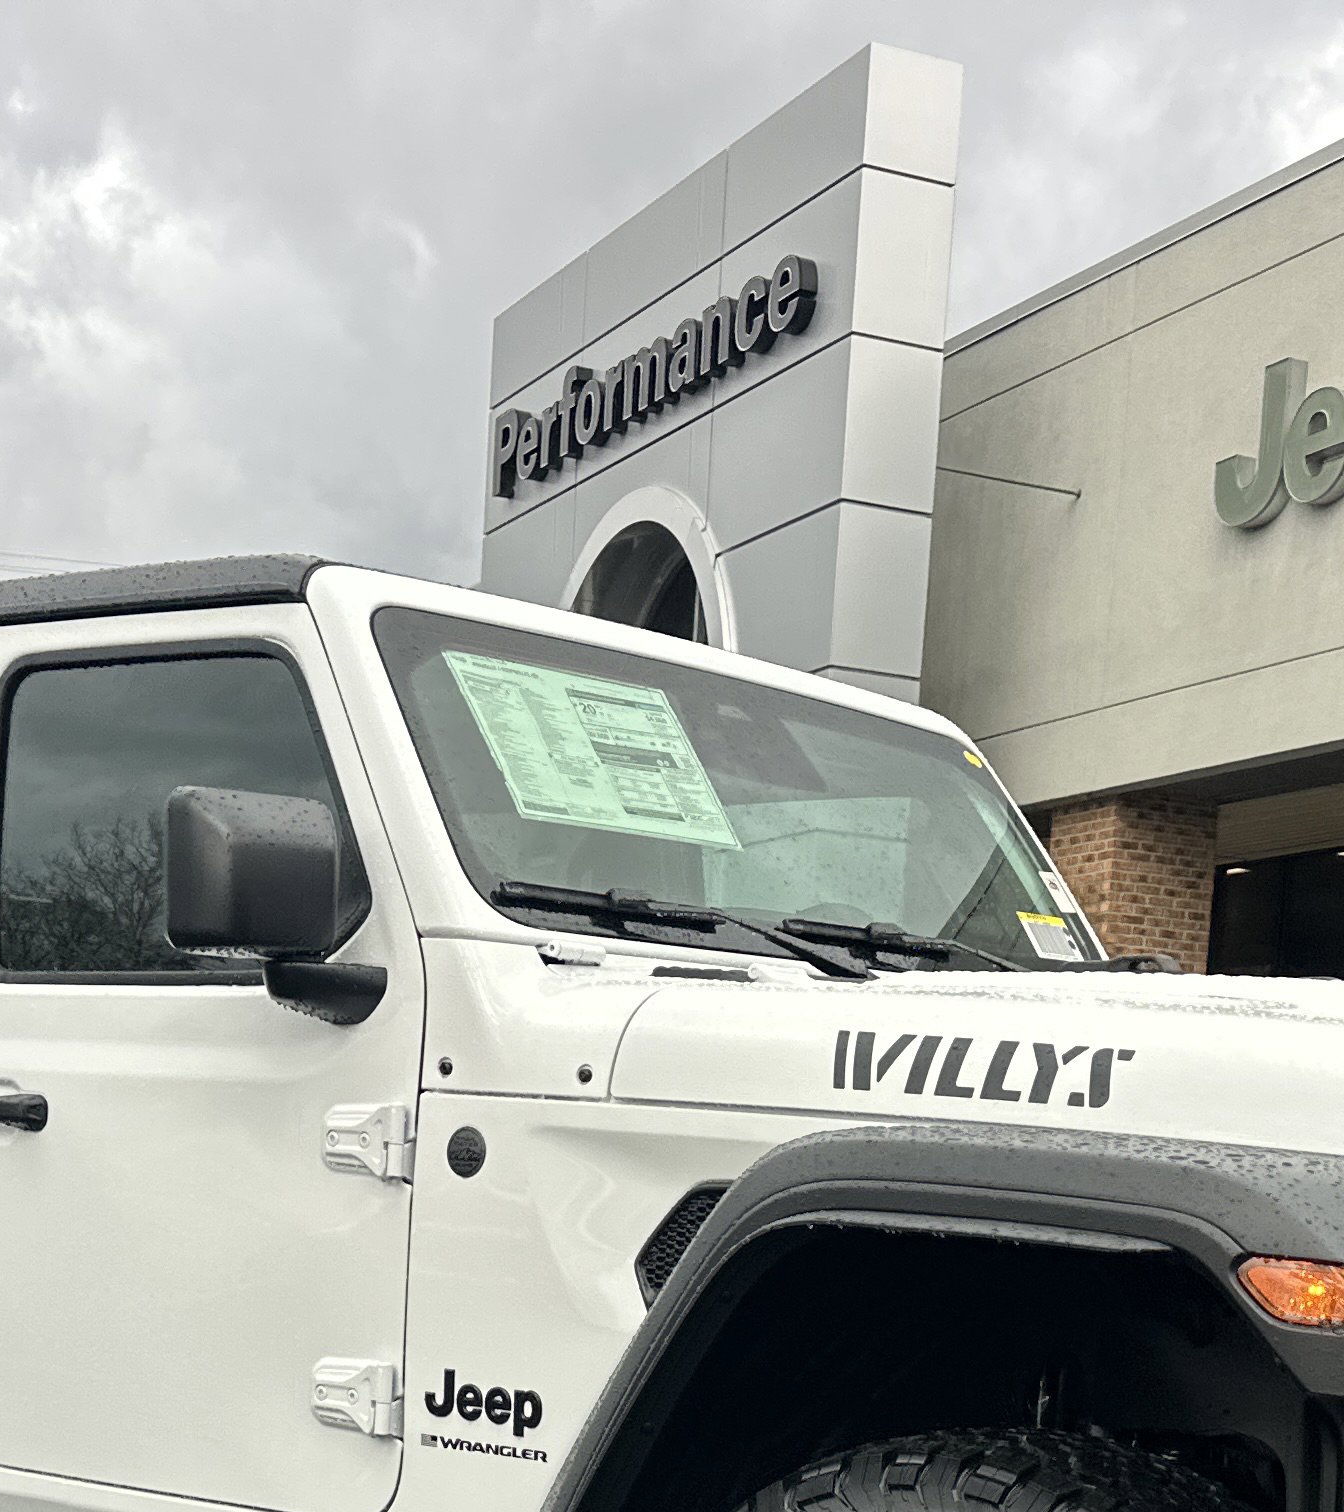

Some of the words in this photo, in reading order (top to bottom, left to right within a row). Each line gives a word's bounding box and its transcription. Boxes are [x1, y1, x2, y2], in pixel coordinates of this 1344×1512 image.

[492, 254, 818, 498] Performance
[832, 1029, 1137, 1109] WILLYS
[424, 1367, 543, 1438] Jeep
[439, 1435, 548, 1464] WRANGLER
